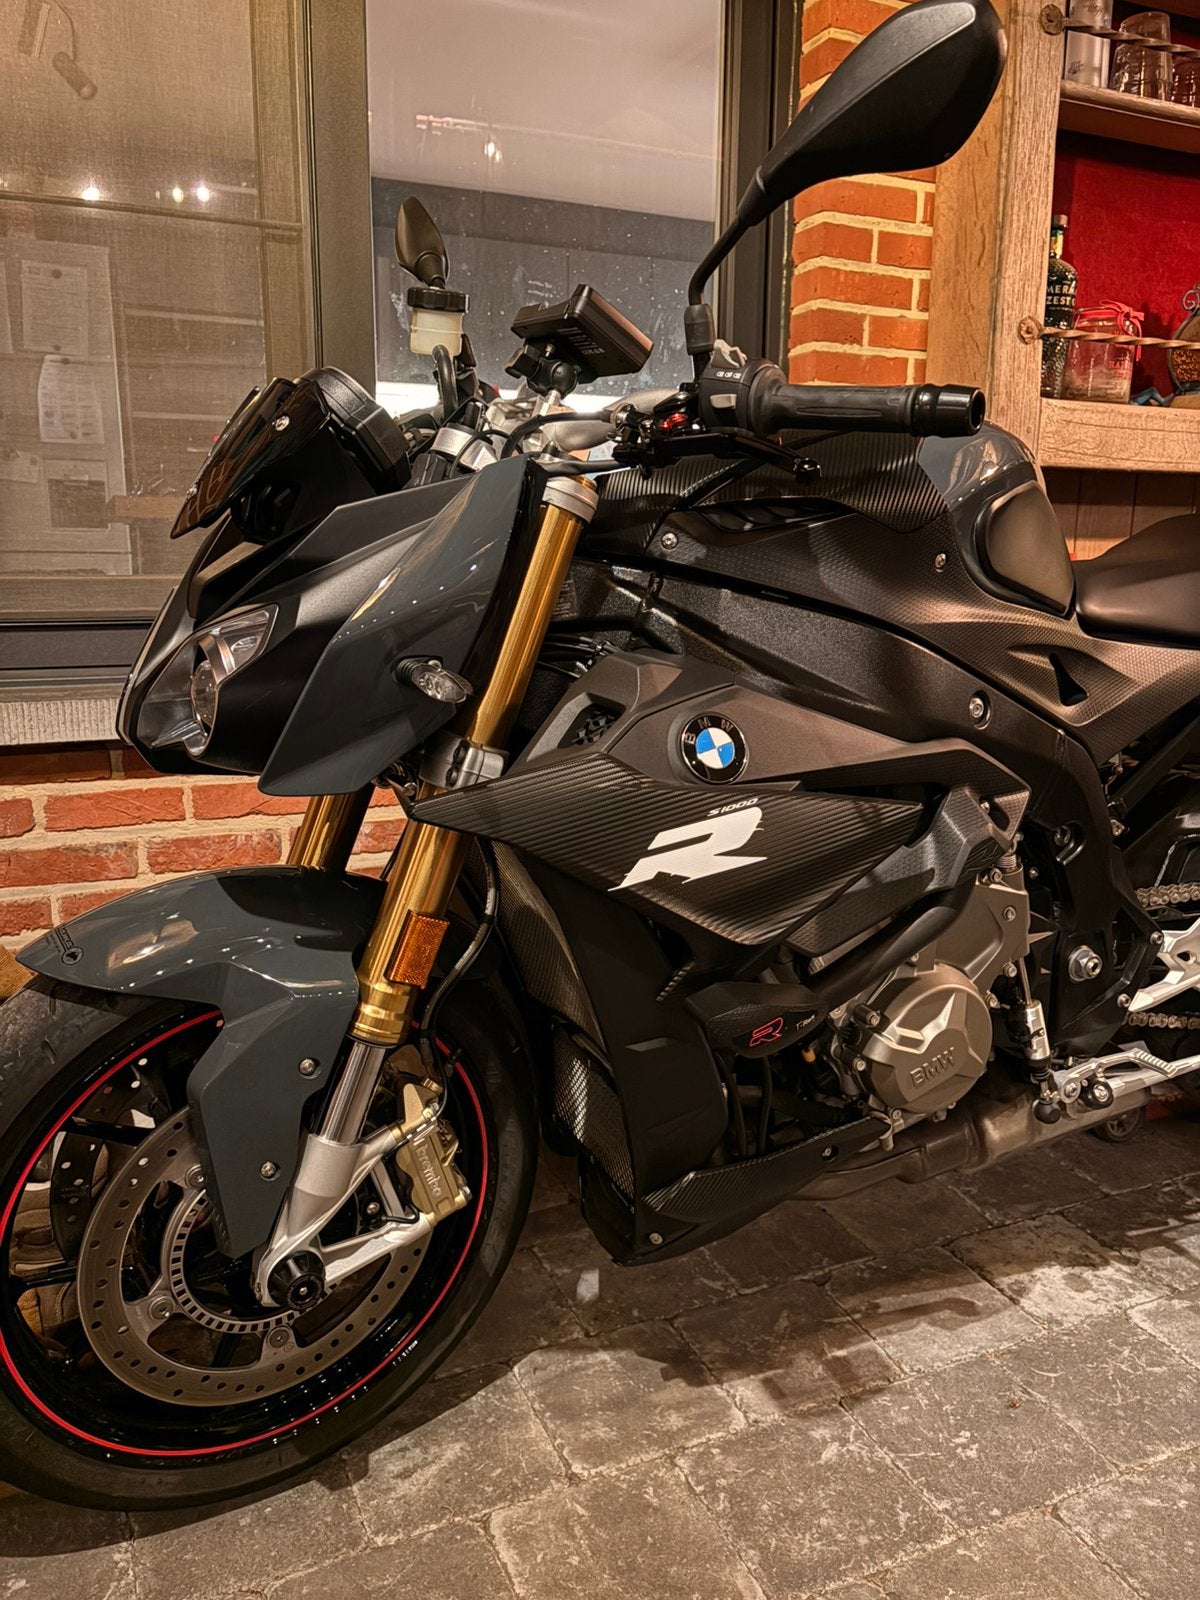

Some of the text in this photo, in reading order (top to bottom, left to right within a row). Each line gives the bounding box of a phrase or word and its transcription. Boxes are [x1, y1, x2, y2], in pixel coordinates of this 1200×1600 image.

[685, 716, 734, 745] BMW
[707, 798, 759, 817] S1000
[607, 806, 768, 892] R
[910, 1046, 955, 1089] BMW
[415, 1143, 442, 1198] brembo
